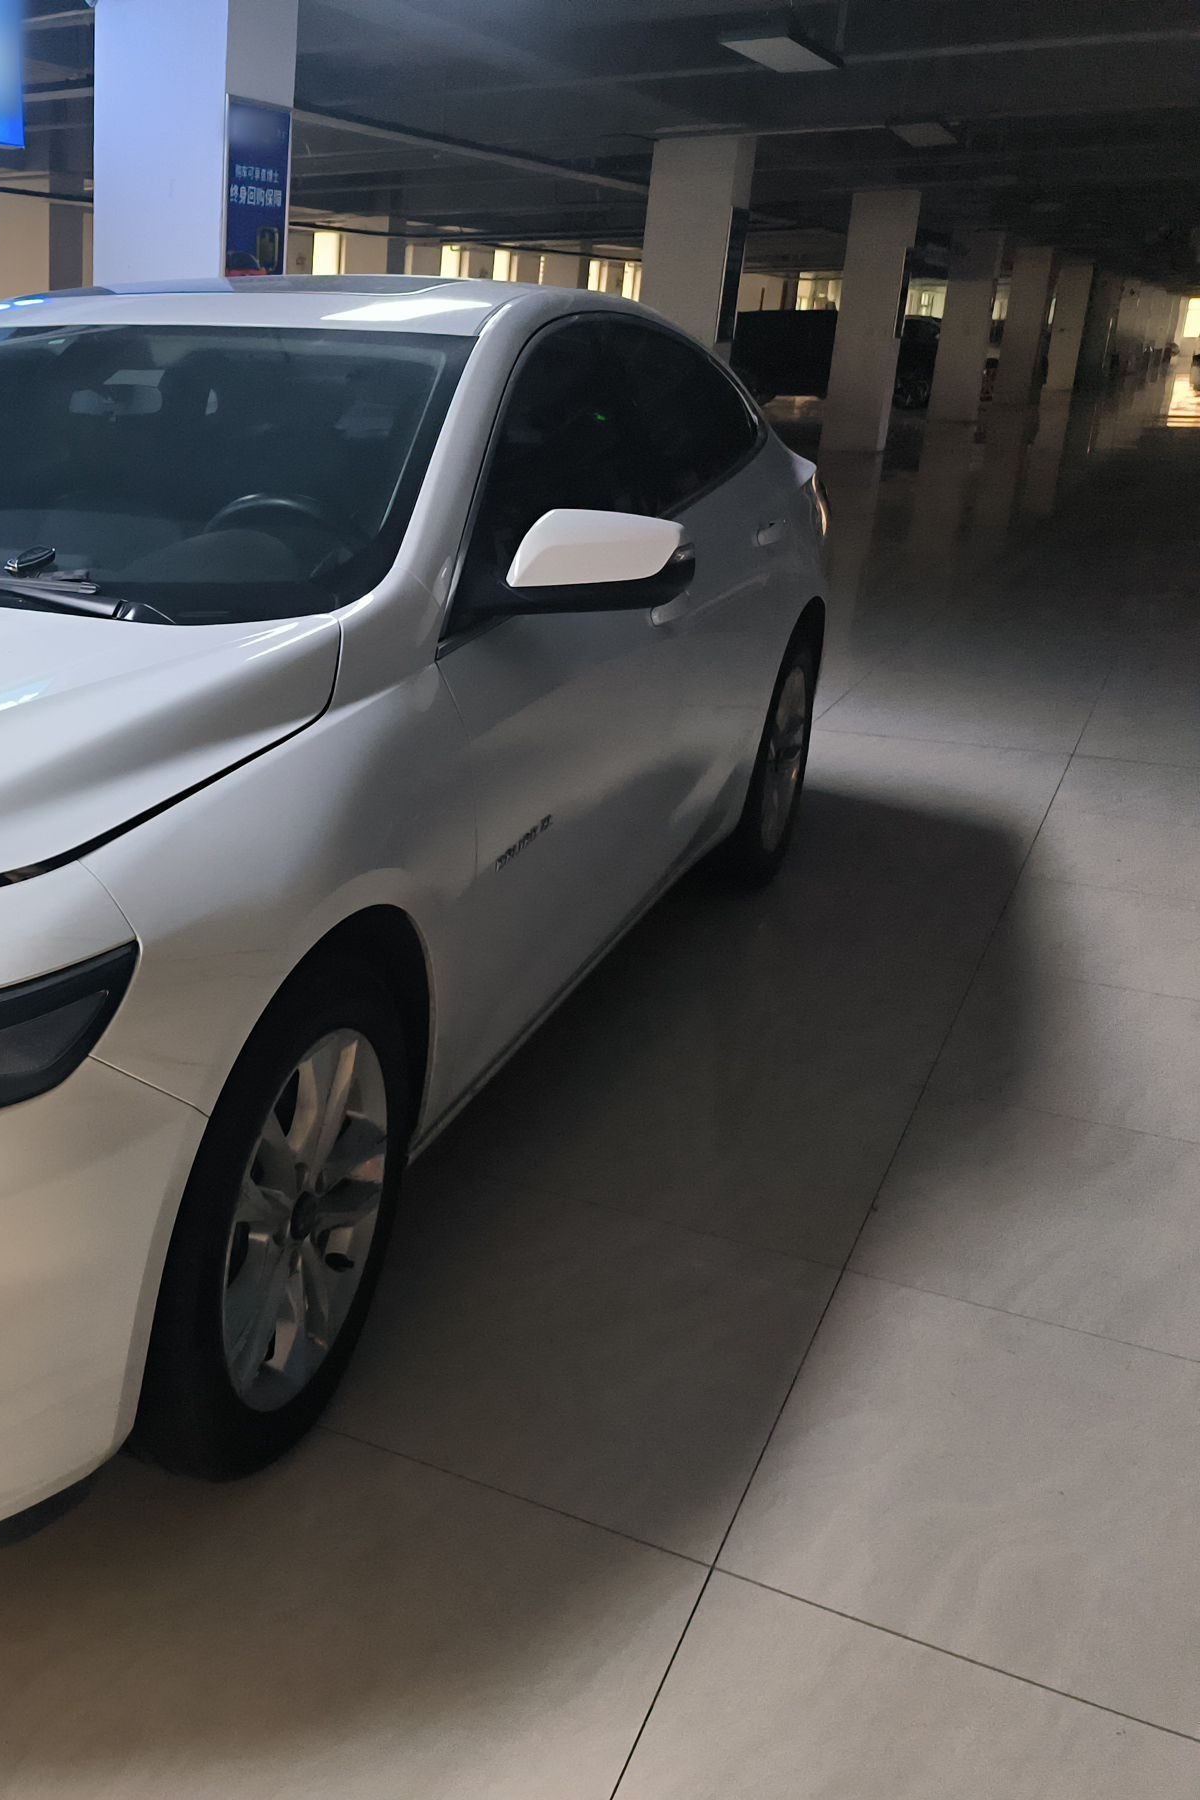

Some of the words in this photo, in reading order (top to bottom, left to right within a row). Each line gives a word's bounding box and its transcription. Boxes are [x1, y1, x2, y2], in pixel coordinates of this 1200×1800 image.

[230, 184, 282, 207] 终身回购保障
